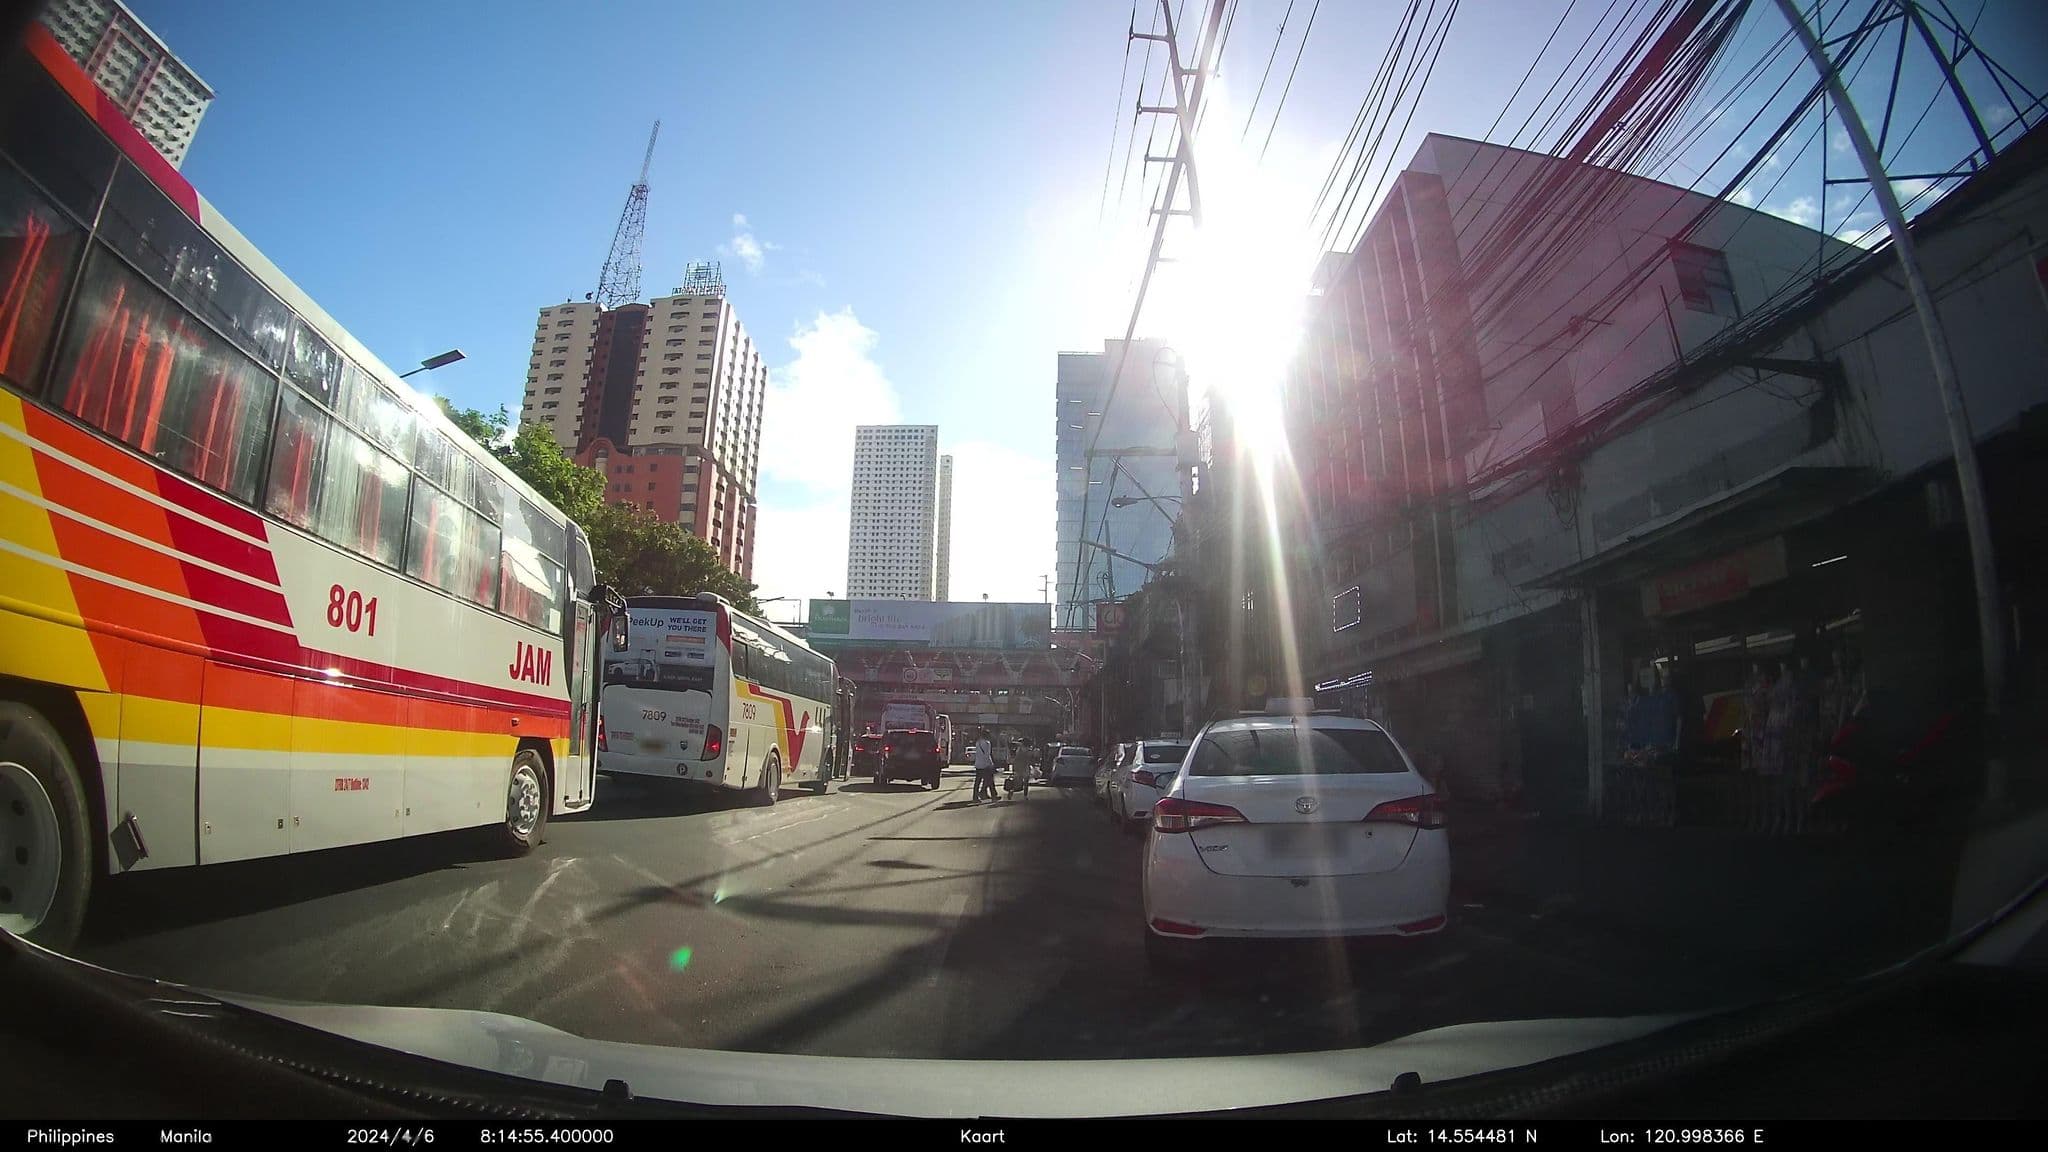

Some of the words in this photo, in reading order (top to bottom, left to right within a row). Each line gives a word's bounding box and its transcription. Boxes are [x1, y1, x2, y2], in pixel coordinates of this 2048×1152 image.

[327, 583, 378, 636] 801
[692, 617, 707, 625] GET
[684, 625, 707, 633] THERE
[509, 641, 552, 687] JAM
[641, 709, 667, 722] 7809
[742, 702, 757, 720] 7809
